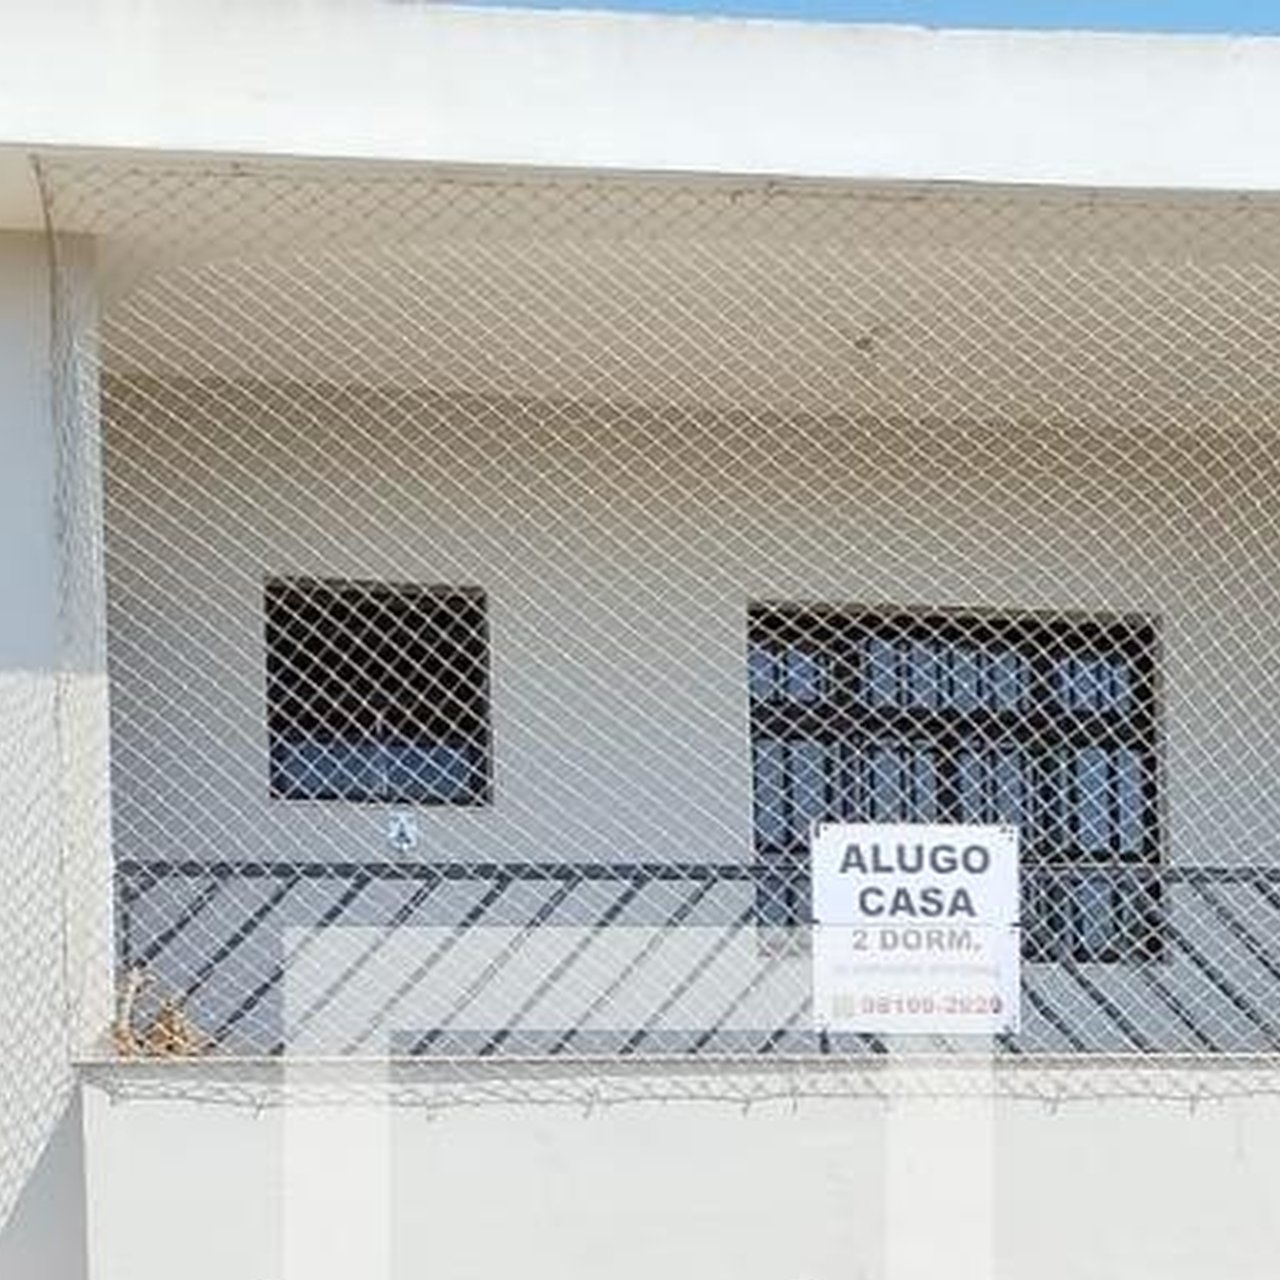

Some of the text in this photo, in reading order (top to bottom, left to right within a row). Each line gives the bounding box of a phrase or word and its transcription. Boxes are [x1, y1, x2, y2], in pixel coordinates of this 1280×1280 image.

[838, 843, 992, 875] ALUGO
[858, 886, 977, 918] CASA
[851, 928, 983, 953] 2 DORM.
